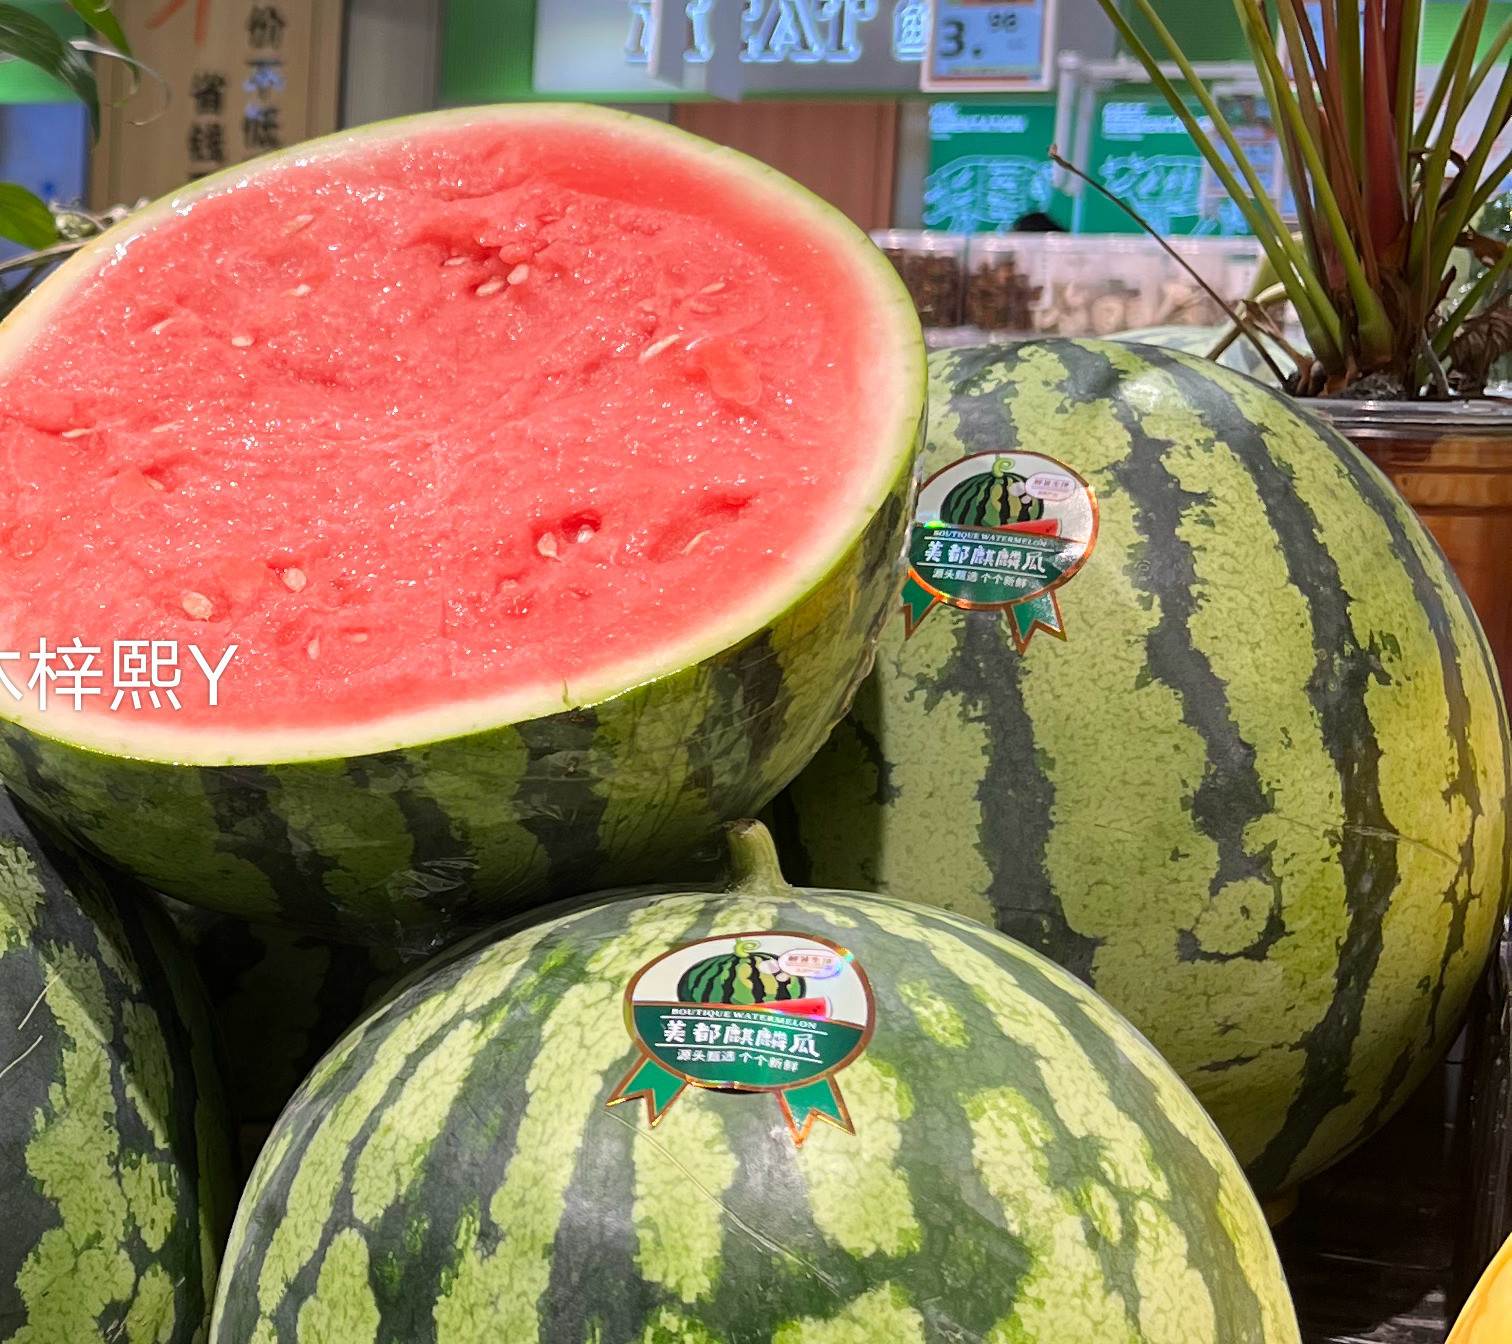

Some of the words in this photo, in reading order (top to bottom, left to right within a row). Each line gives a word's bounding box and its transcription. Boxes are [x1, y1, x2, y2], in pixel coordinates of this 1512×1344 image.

[925, 541, 1045, 573] 美都麒麟瓜
[671, 1008, 731, 1019] BOUTIQUE
[733, 1011, 817, 1029] WATERMELON
[664, 1020, 820, 1058] 美都麒麟瓜
